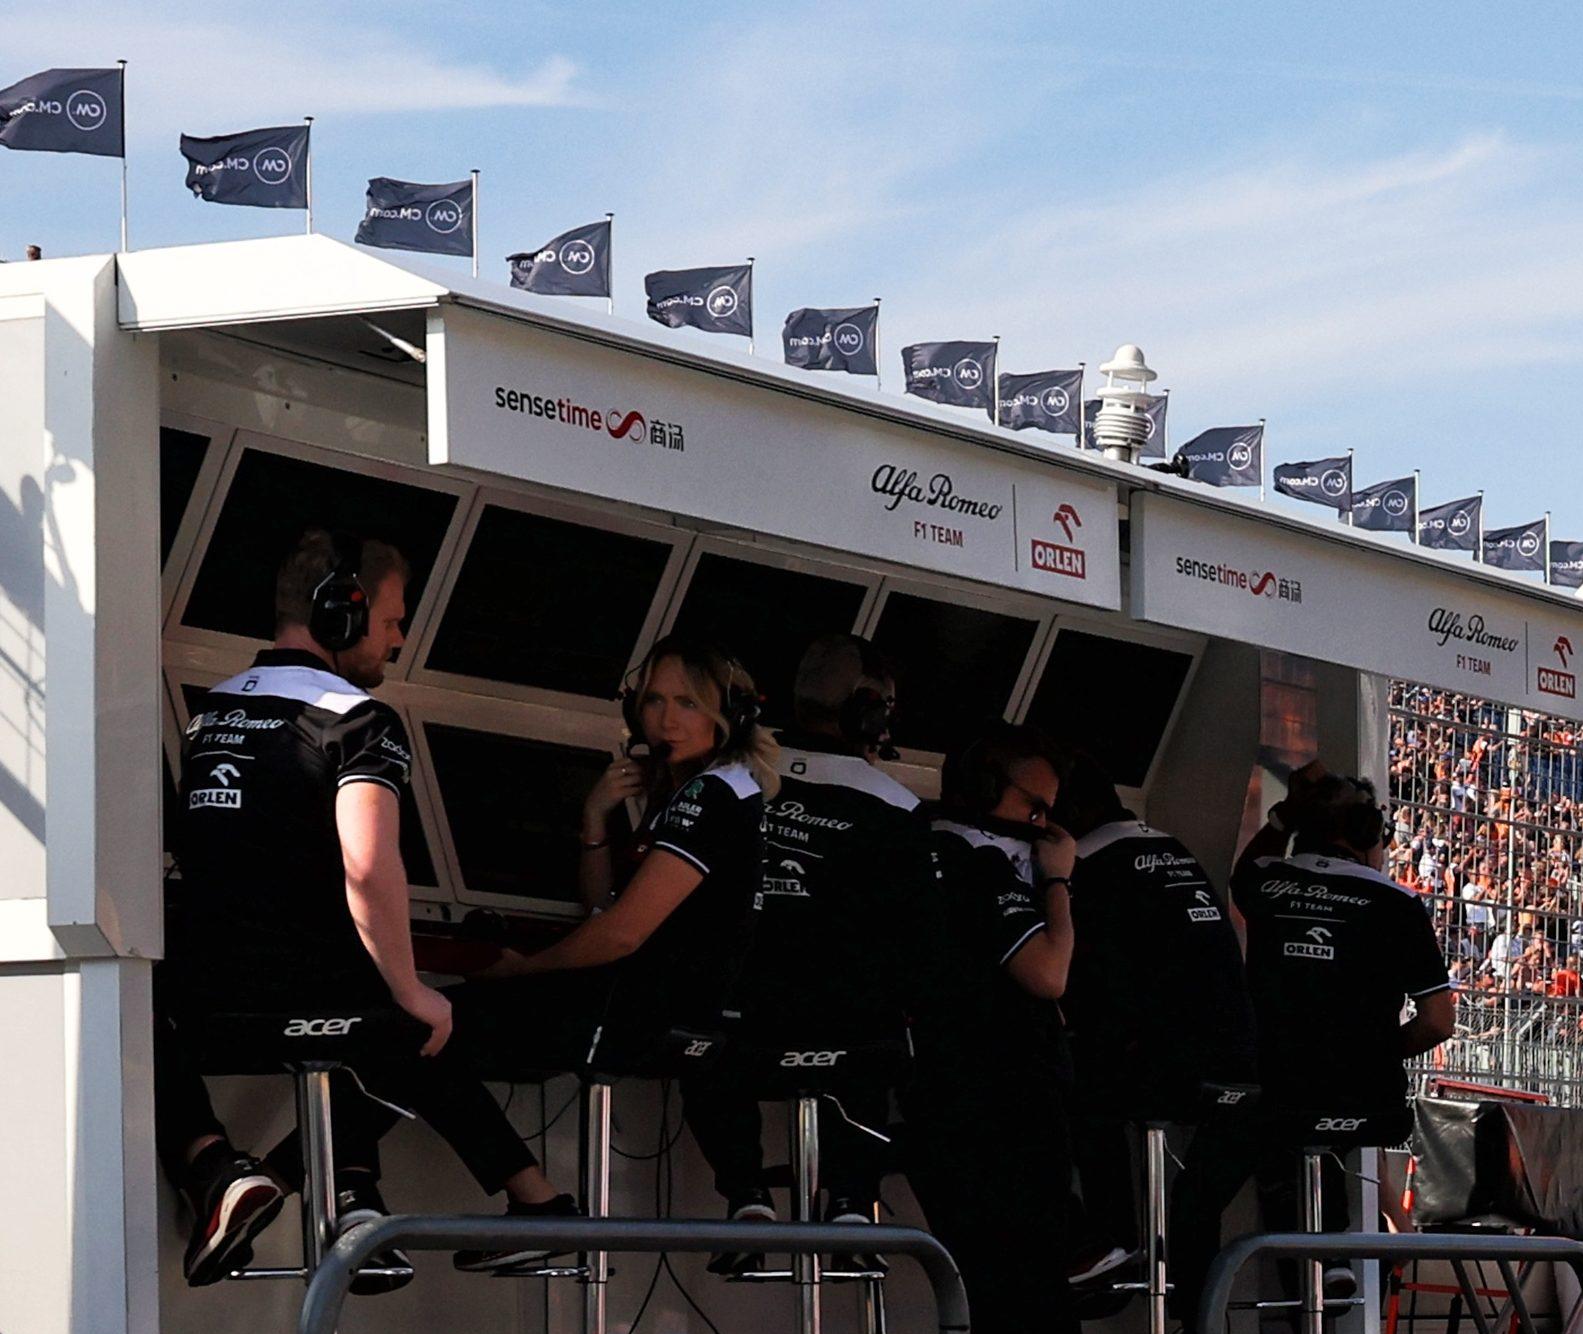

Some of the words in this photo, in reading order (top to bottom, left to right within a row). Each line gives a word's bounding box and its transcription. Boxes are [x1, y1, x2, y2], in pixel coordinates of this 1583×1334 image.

[495, 387, 602, 430] sensetime
[871, 464, 926, 511] Alfa
[926, 473, 1003, 519] Romeo
[914, 520, 927, 539] F1
[930, 524, 964, 547] TEAM
[1033, 546, 1083, 575] ORLEN
[1176, 556, 1247, 589] sensetime
[1428, 607, 1466, 647] Alfa
[1466, 614, 1519, 652] Romeo
[1456, 653, 1466, 670] F1
[1468, 656, 1492, 676] TEAM
[1539, 671, 1574, 695] ORLEN
[222, 709, 284, 731] Romeo
[214, 734, 245, 746] TEAM
[779, 800, 854, 831] Romeo
[777, 824, 810, 844] TEAM
[1259, 880, 1302, 900] Alfa
[1302, 884, 1371, 907] Romeo
[1303, 902, 1334, 913] TEAM
[1287, 944, 1331, 957] ORLEN
[284, 1017, 362, 1037] acer
[780, 1050, 848, 1067] acer
[1315, 1118, 1368, 1132] acer
